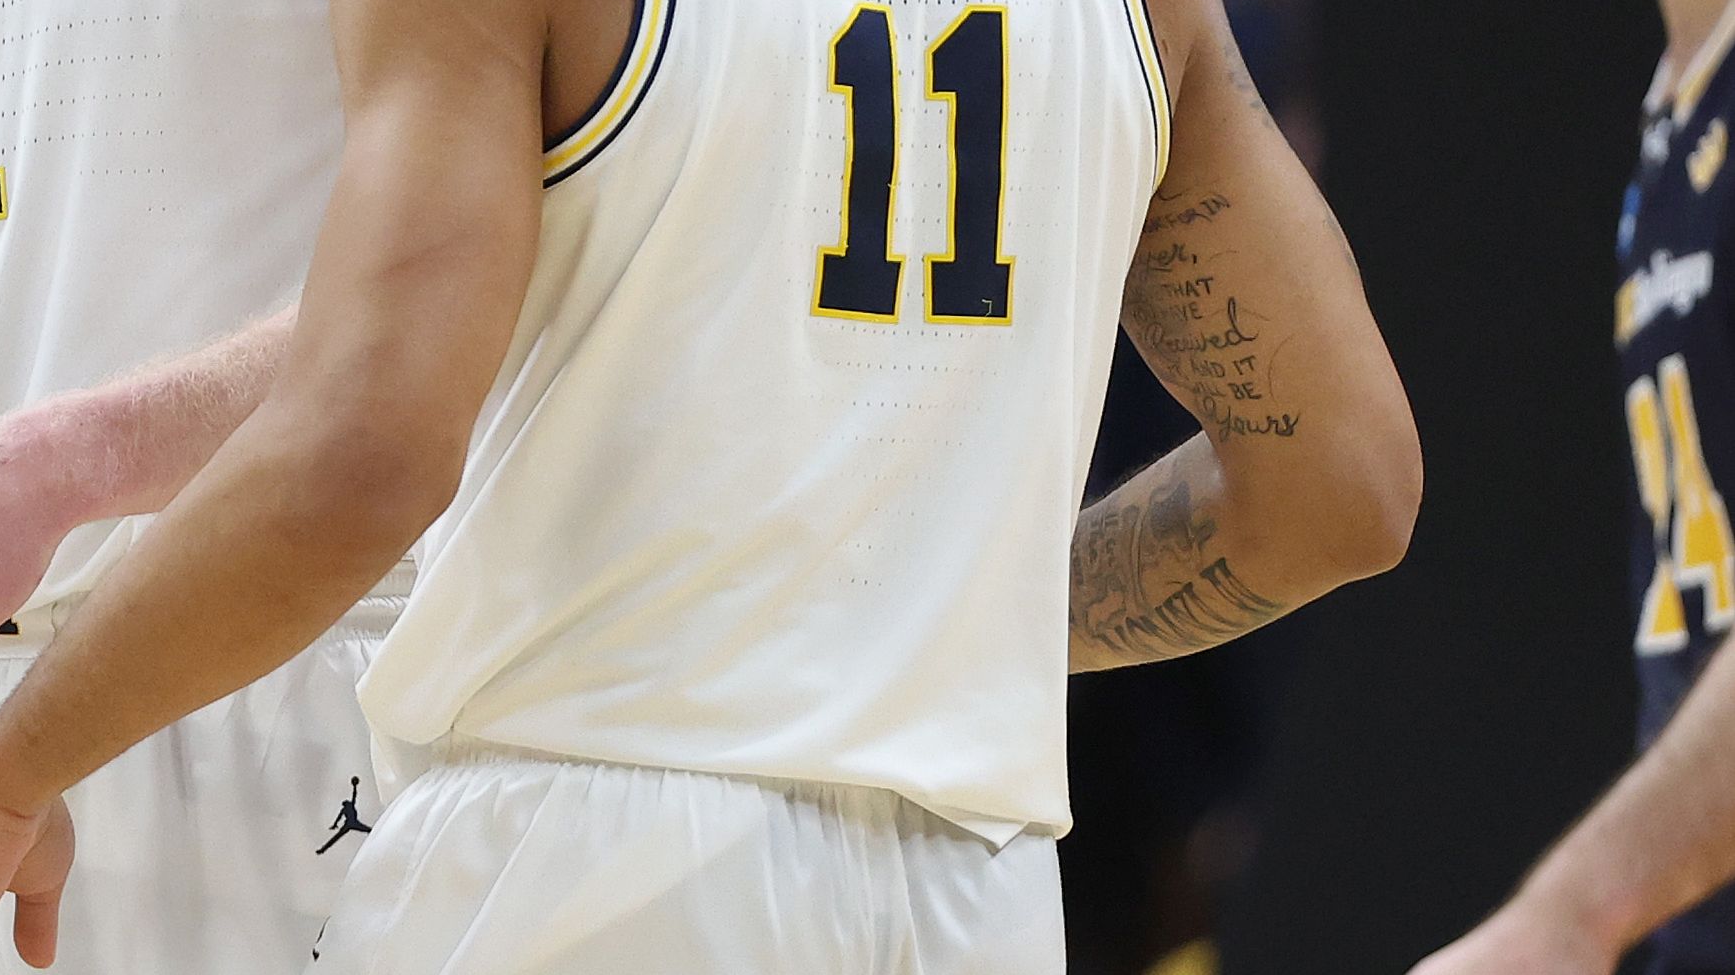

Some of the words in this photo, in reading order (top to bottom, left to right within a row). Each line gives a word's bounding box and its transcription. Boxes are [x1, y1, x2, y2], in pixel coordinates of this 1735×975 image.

[810, 2, 1017, 326] 11
[1231, 355, 1257, 376] IT
[1227, 382, 1263, 400] BE
